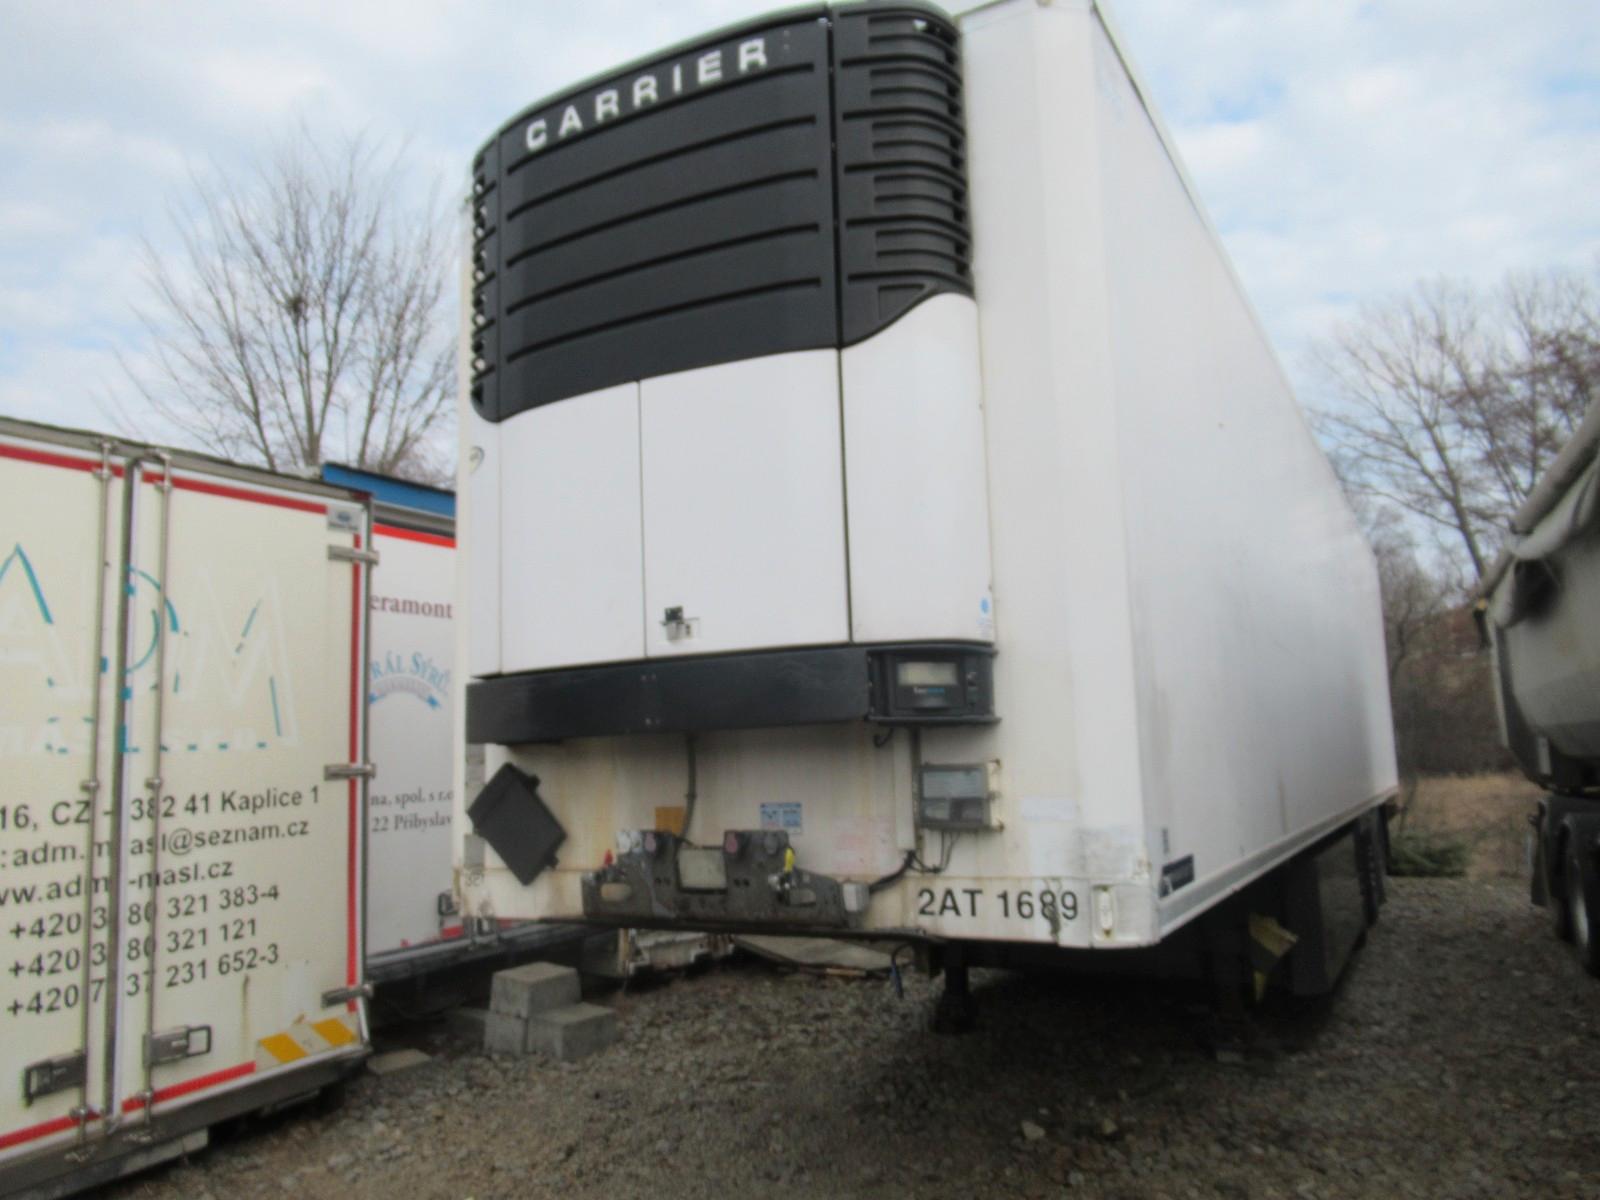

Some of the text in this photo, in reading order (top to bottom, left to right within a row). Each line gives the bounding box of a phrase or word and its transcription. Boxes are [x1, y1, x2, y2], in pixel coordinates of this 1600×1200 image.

[526, 38, 767, 151] CARRIER
[51, 801, 91, 825] CZ
[184, 792, 210, 814] 41
[221, 788, 303, 815] Kaplice
[311, 786, 320, 804] 1
[9, 912, 81, 939] +420
[167, 895, 208, 920] 321
[219, 884, 279, 911] 383-4
[918, 888, 1079, 921] 2AT 1689
[8, 948, 80, 976] +420
[167, 929, 208, 954] 321
[219, 918, 257, 942] 121
[7, 984, 79, 1016] +420
[166, 959, 208, 989] 231
[217, 943, 279, 976] 652-3
